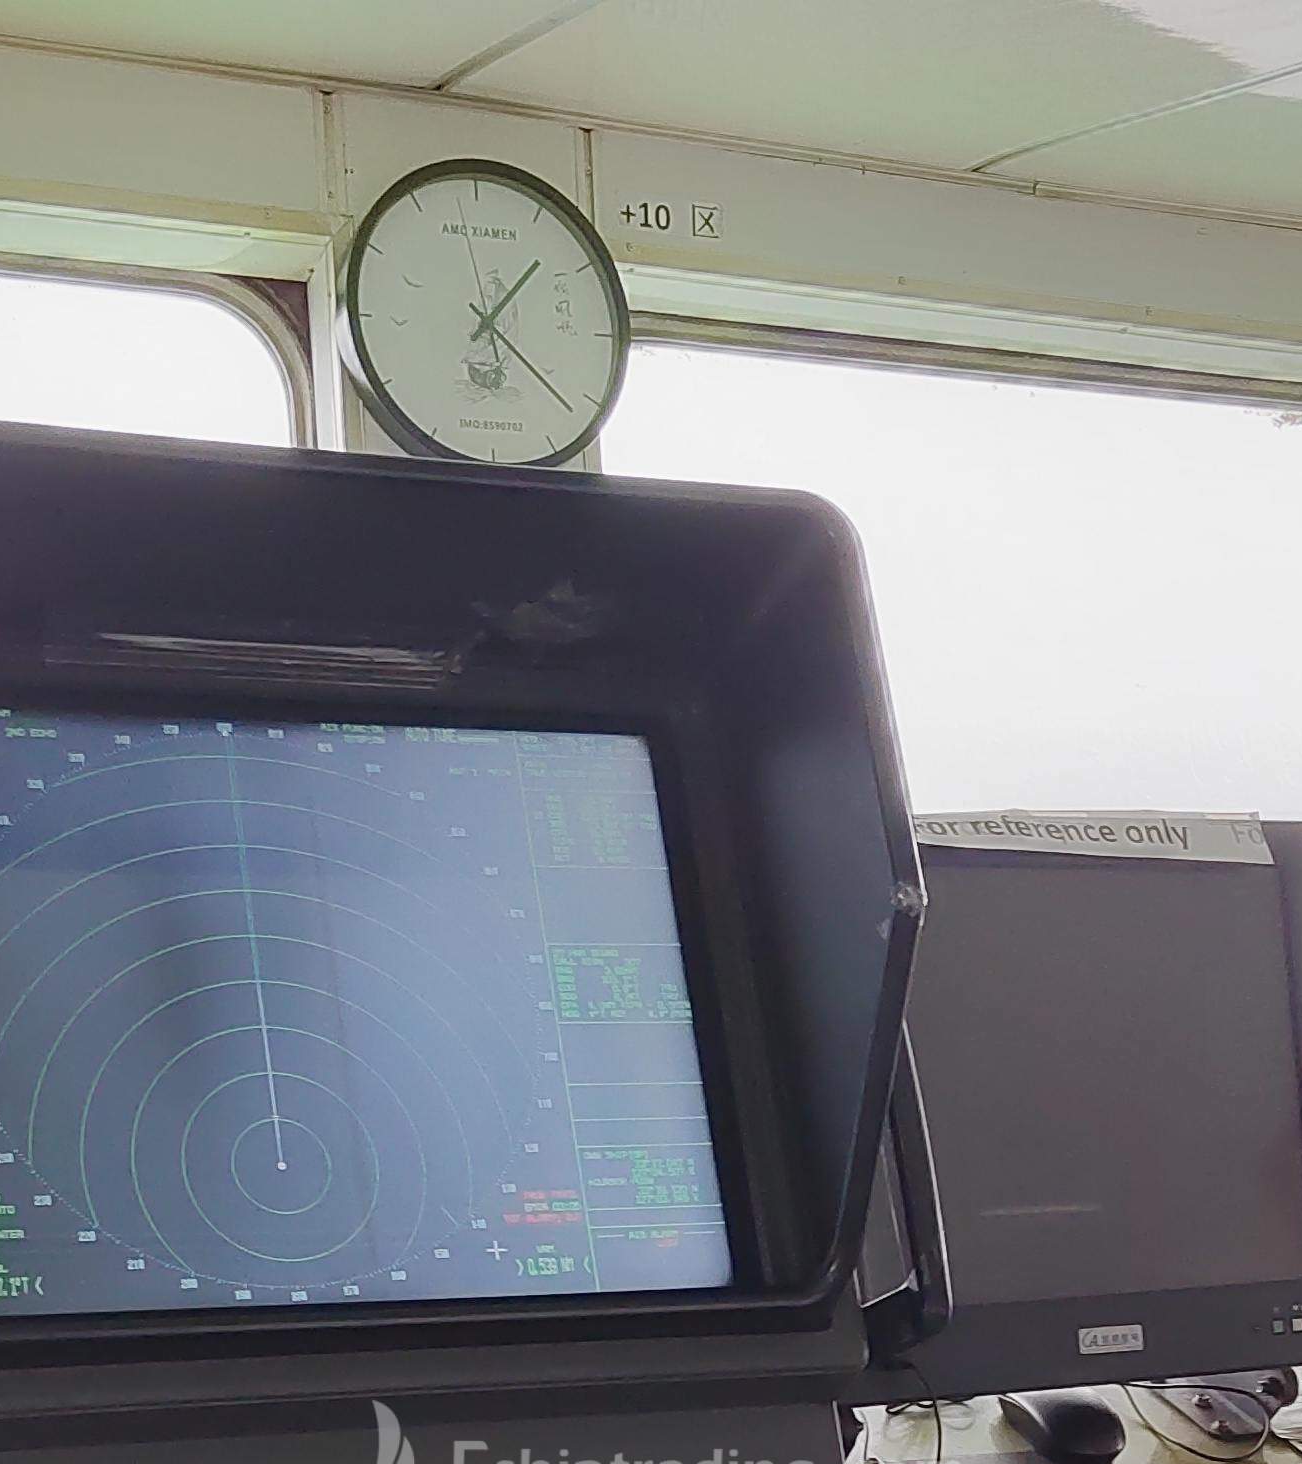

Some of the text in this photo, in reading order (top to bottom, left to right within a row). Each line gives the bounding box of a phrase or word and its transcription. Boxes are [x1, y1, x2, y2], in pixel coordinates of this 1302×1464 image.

[620, 202, 671, 231] +10
[470, 225, 518, 241] XIAMEN
[970, 815, 1117, 845] reference
[1125, 818, 1190, 851] only
